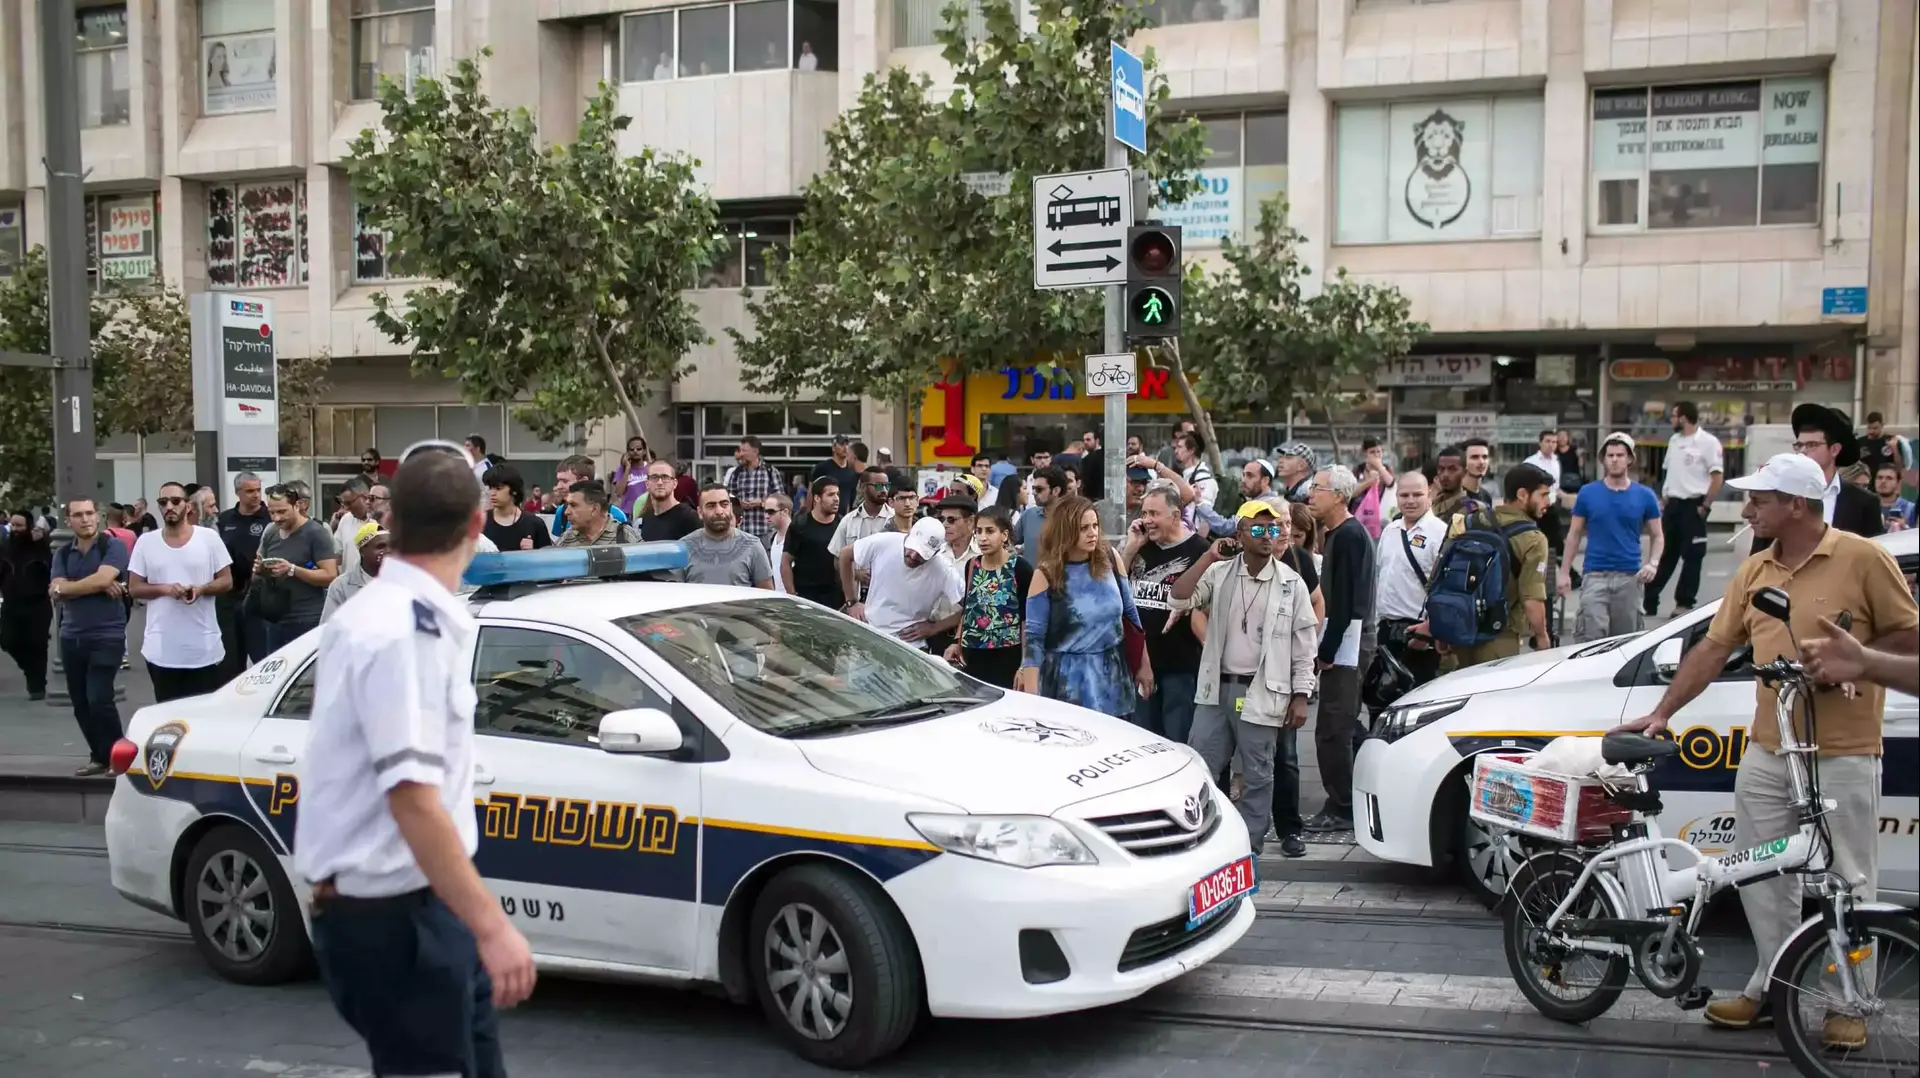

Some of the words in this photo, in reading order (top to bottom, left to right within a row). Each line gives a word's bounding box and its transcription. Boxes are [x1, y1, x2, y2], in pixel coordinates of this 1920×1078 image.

[1774, 90, 1811, 109] NOW
[1785, 113, 1797, 126] IN
[1763, 131, 1818, 150] JERUSALEM
[1435, 357, 1481, 374] יוסי
[226, 382, 272, 393] HA-DAVIDKA
[260, 659, 285, 673] 100
[1066, 753, 1131, 788] POLICE
[485, 792, 679, 855] משטרה
[1709, 816, 1736, 831] 10
